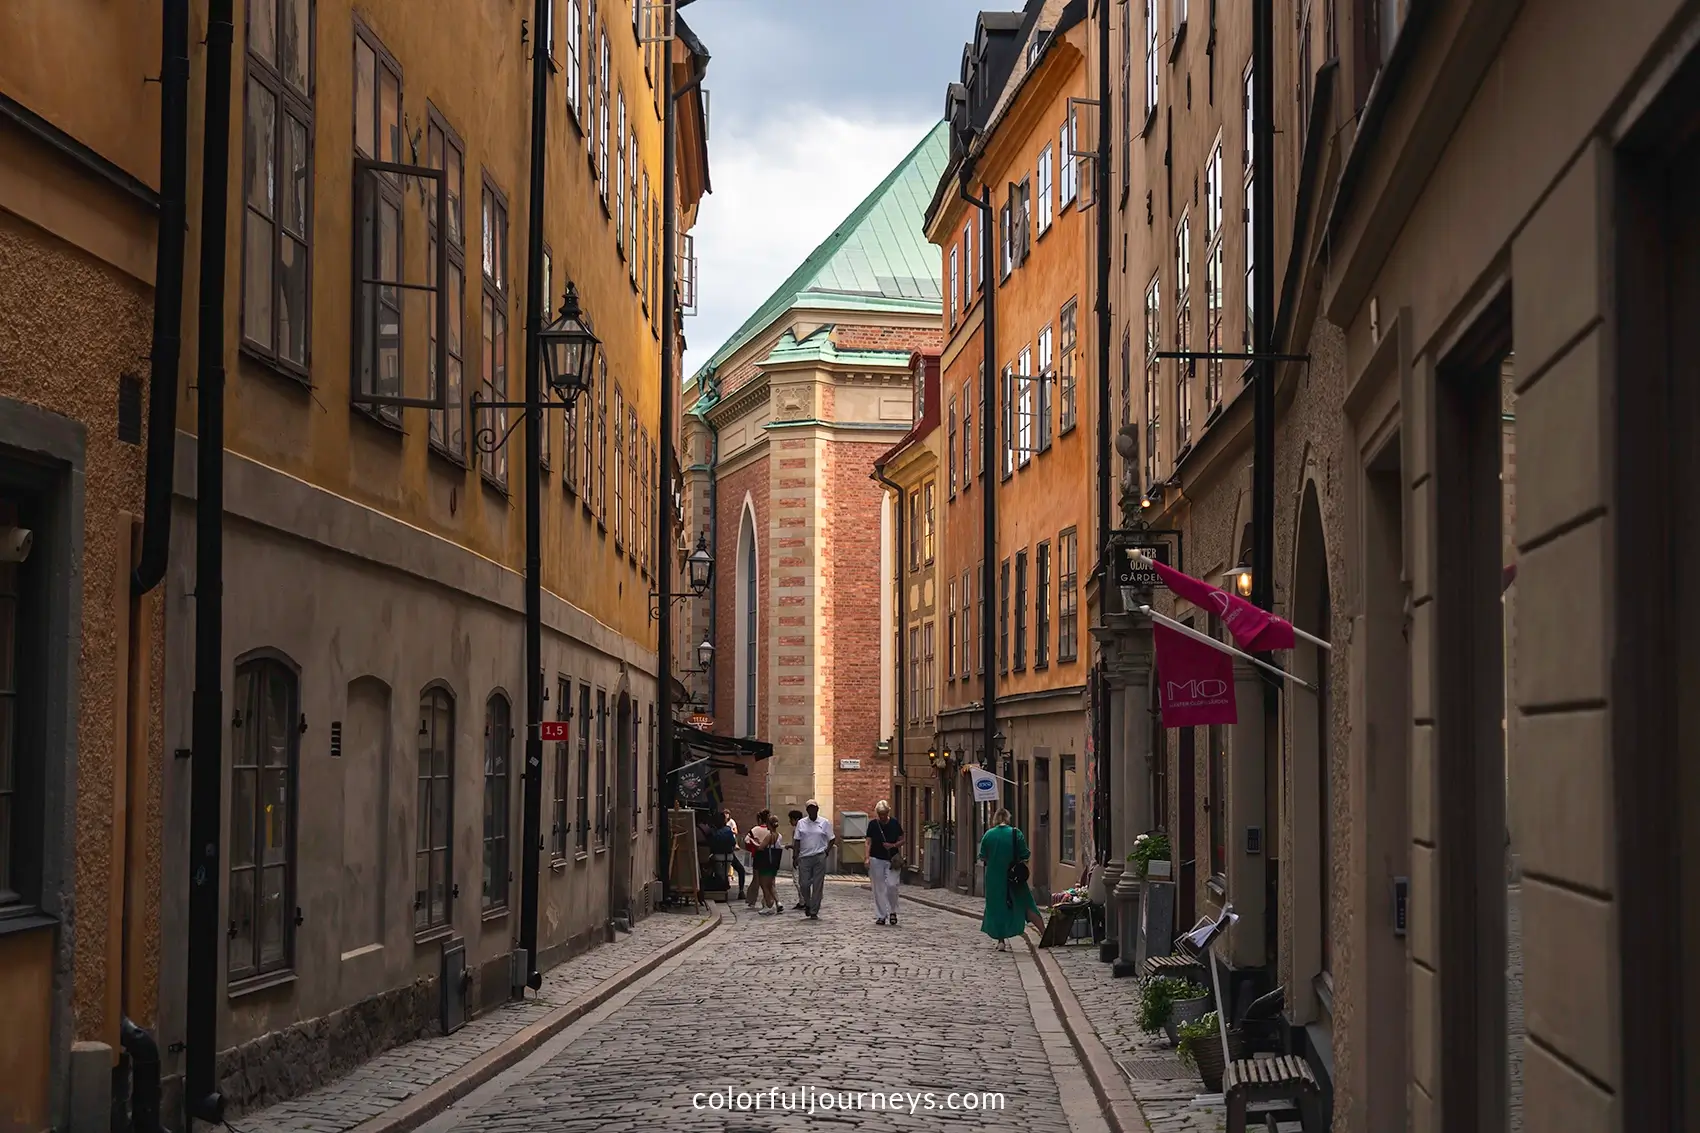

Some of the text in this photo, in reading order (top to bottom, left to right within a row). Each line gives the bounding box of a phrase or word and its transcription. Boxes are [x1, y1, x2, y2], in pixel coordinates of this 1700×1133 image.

[1120, 572, 1163, 582] GÅRDEN
[1167, 679, 1227, 701] MO
[545, 725, 563, 736] 1,5
